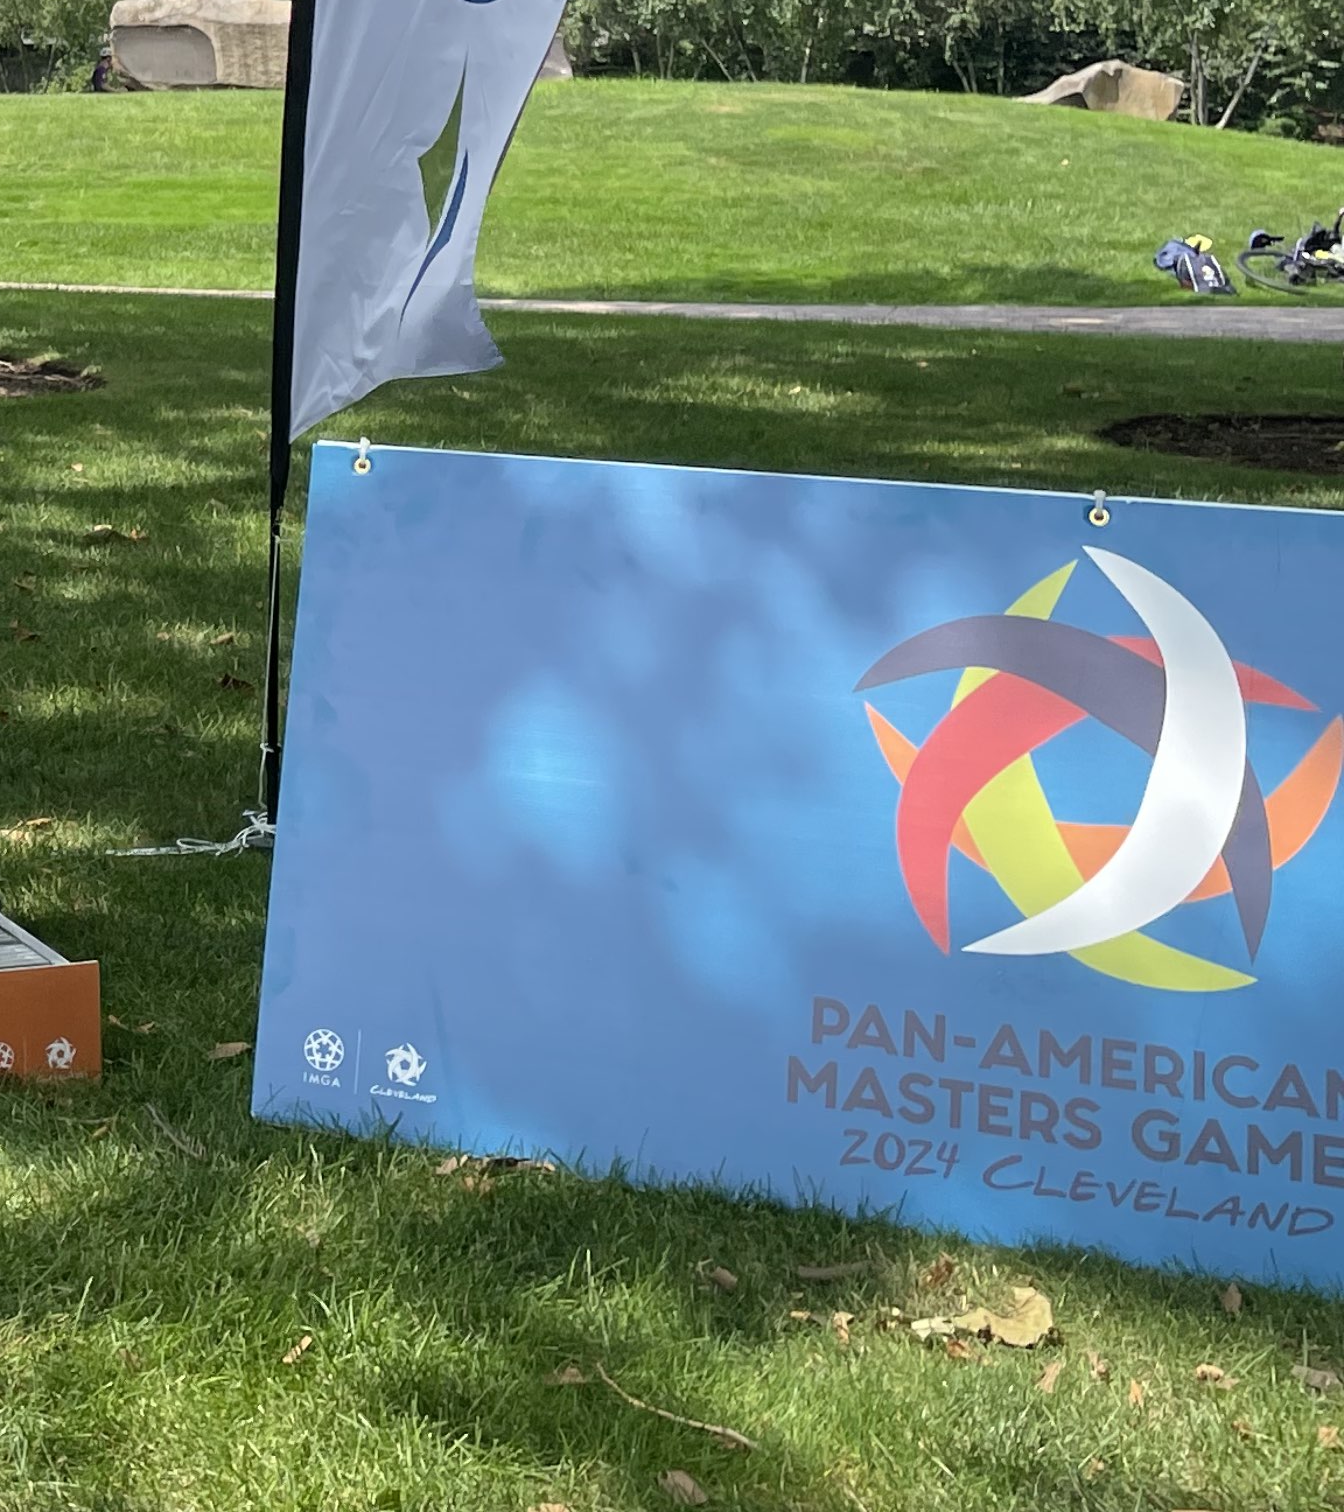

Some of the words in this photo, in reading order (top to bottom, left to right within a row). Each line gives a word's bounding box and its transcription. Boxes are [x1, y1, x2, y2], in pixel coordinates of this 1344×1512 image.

[302, 1070, 342, 1088] IMGA
[786, 1054, 1103, 1150] MASTERS
[1131, 1107, 1344, 1189] GAME
[839, 1128, 961, 1179] 2024
